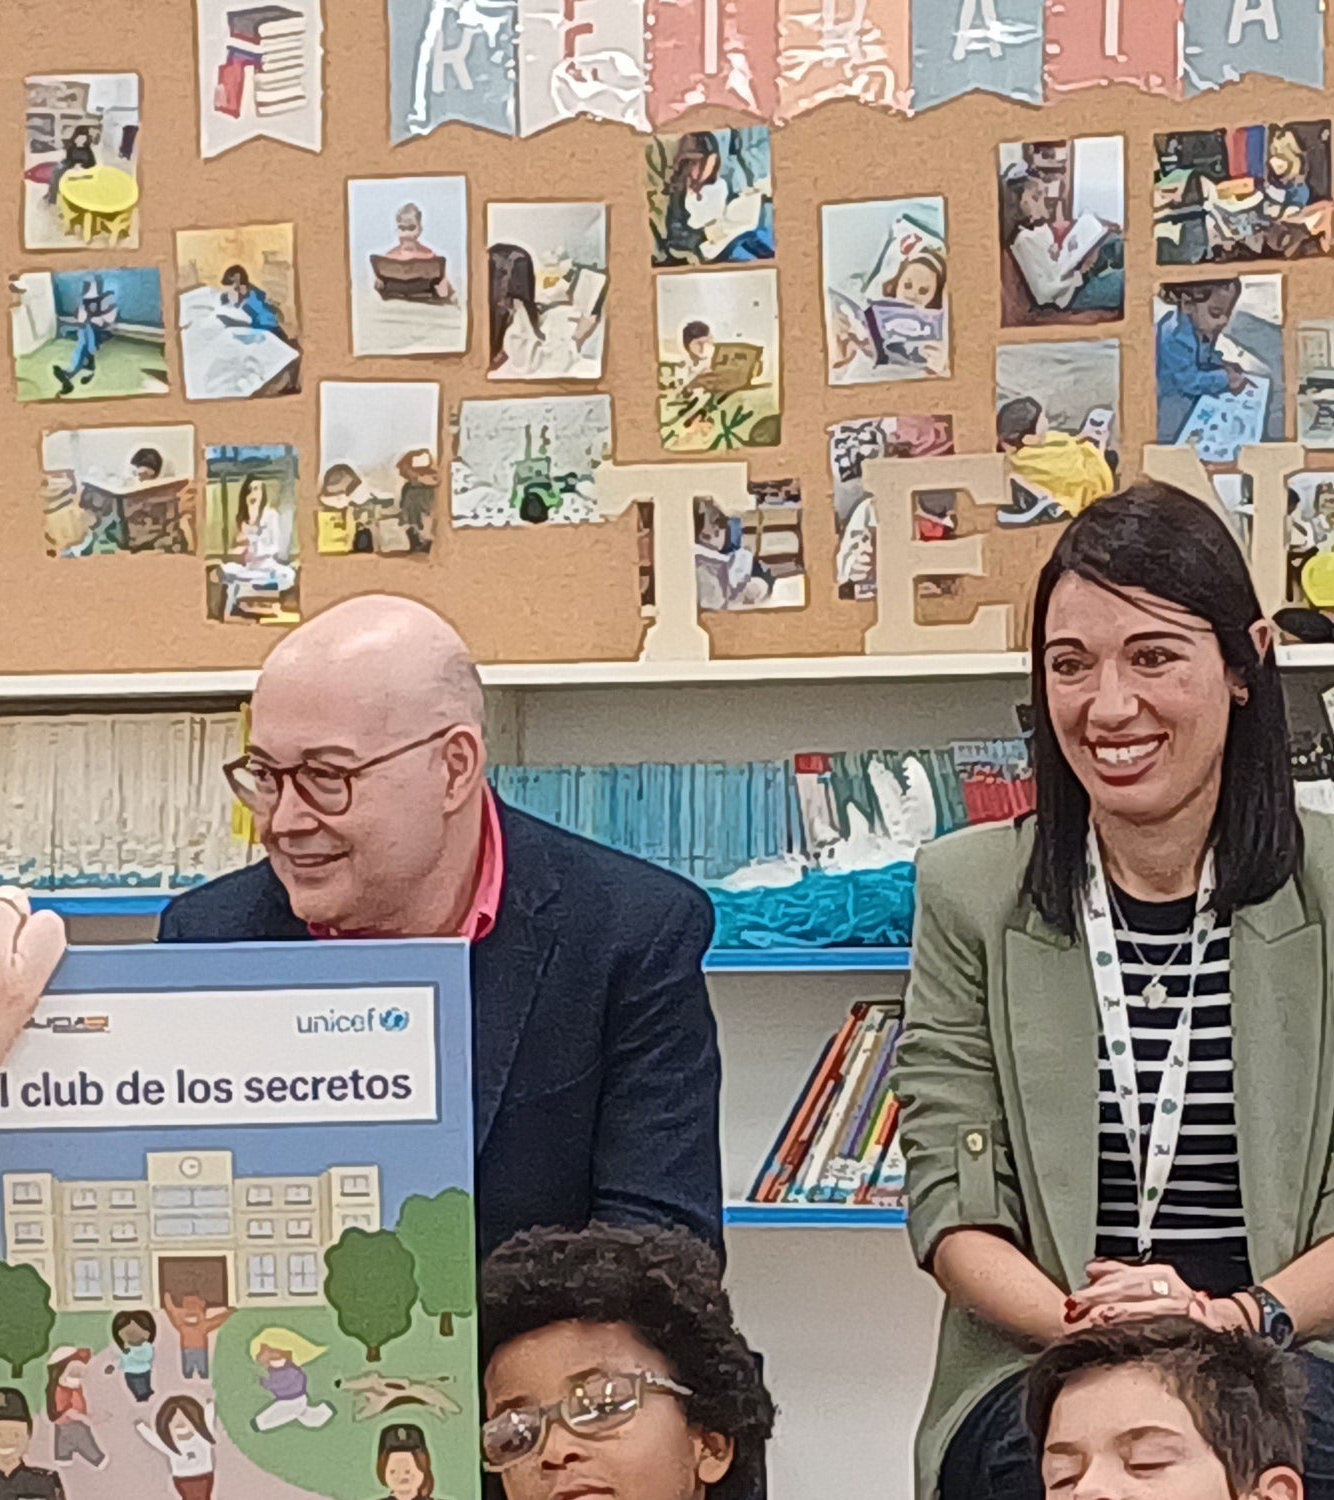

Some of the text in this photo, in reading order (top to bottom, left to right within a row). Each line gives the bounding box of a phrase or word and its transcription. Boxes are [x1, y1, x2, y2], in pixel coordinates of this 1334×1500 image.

[297, 1009, 377, 1034] unicef
[20, 1071, 103, 1107] club
[116, 1070, 165, 1104] de
[177, 1069, 233, 1103] los
[244, 1069, 413, 1102] secretos
